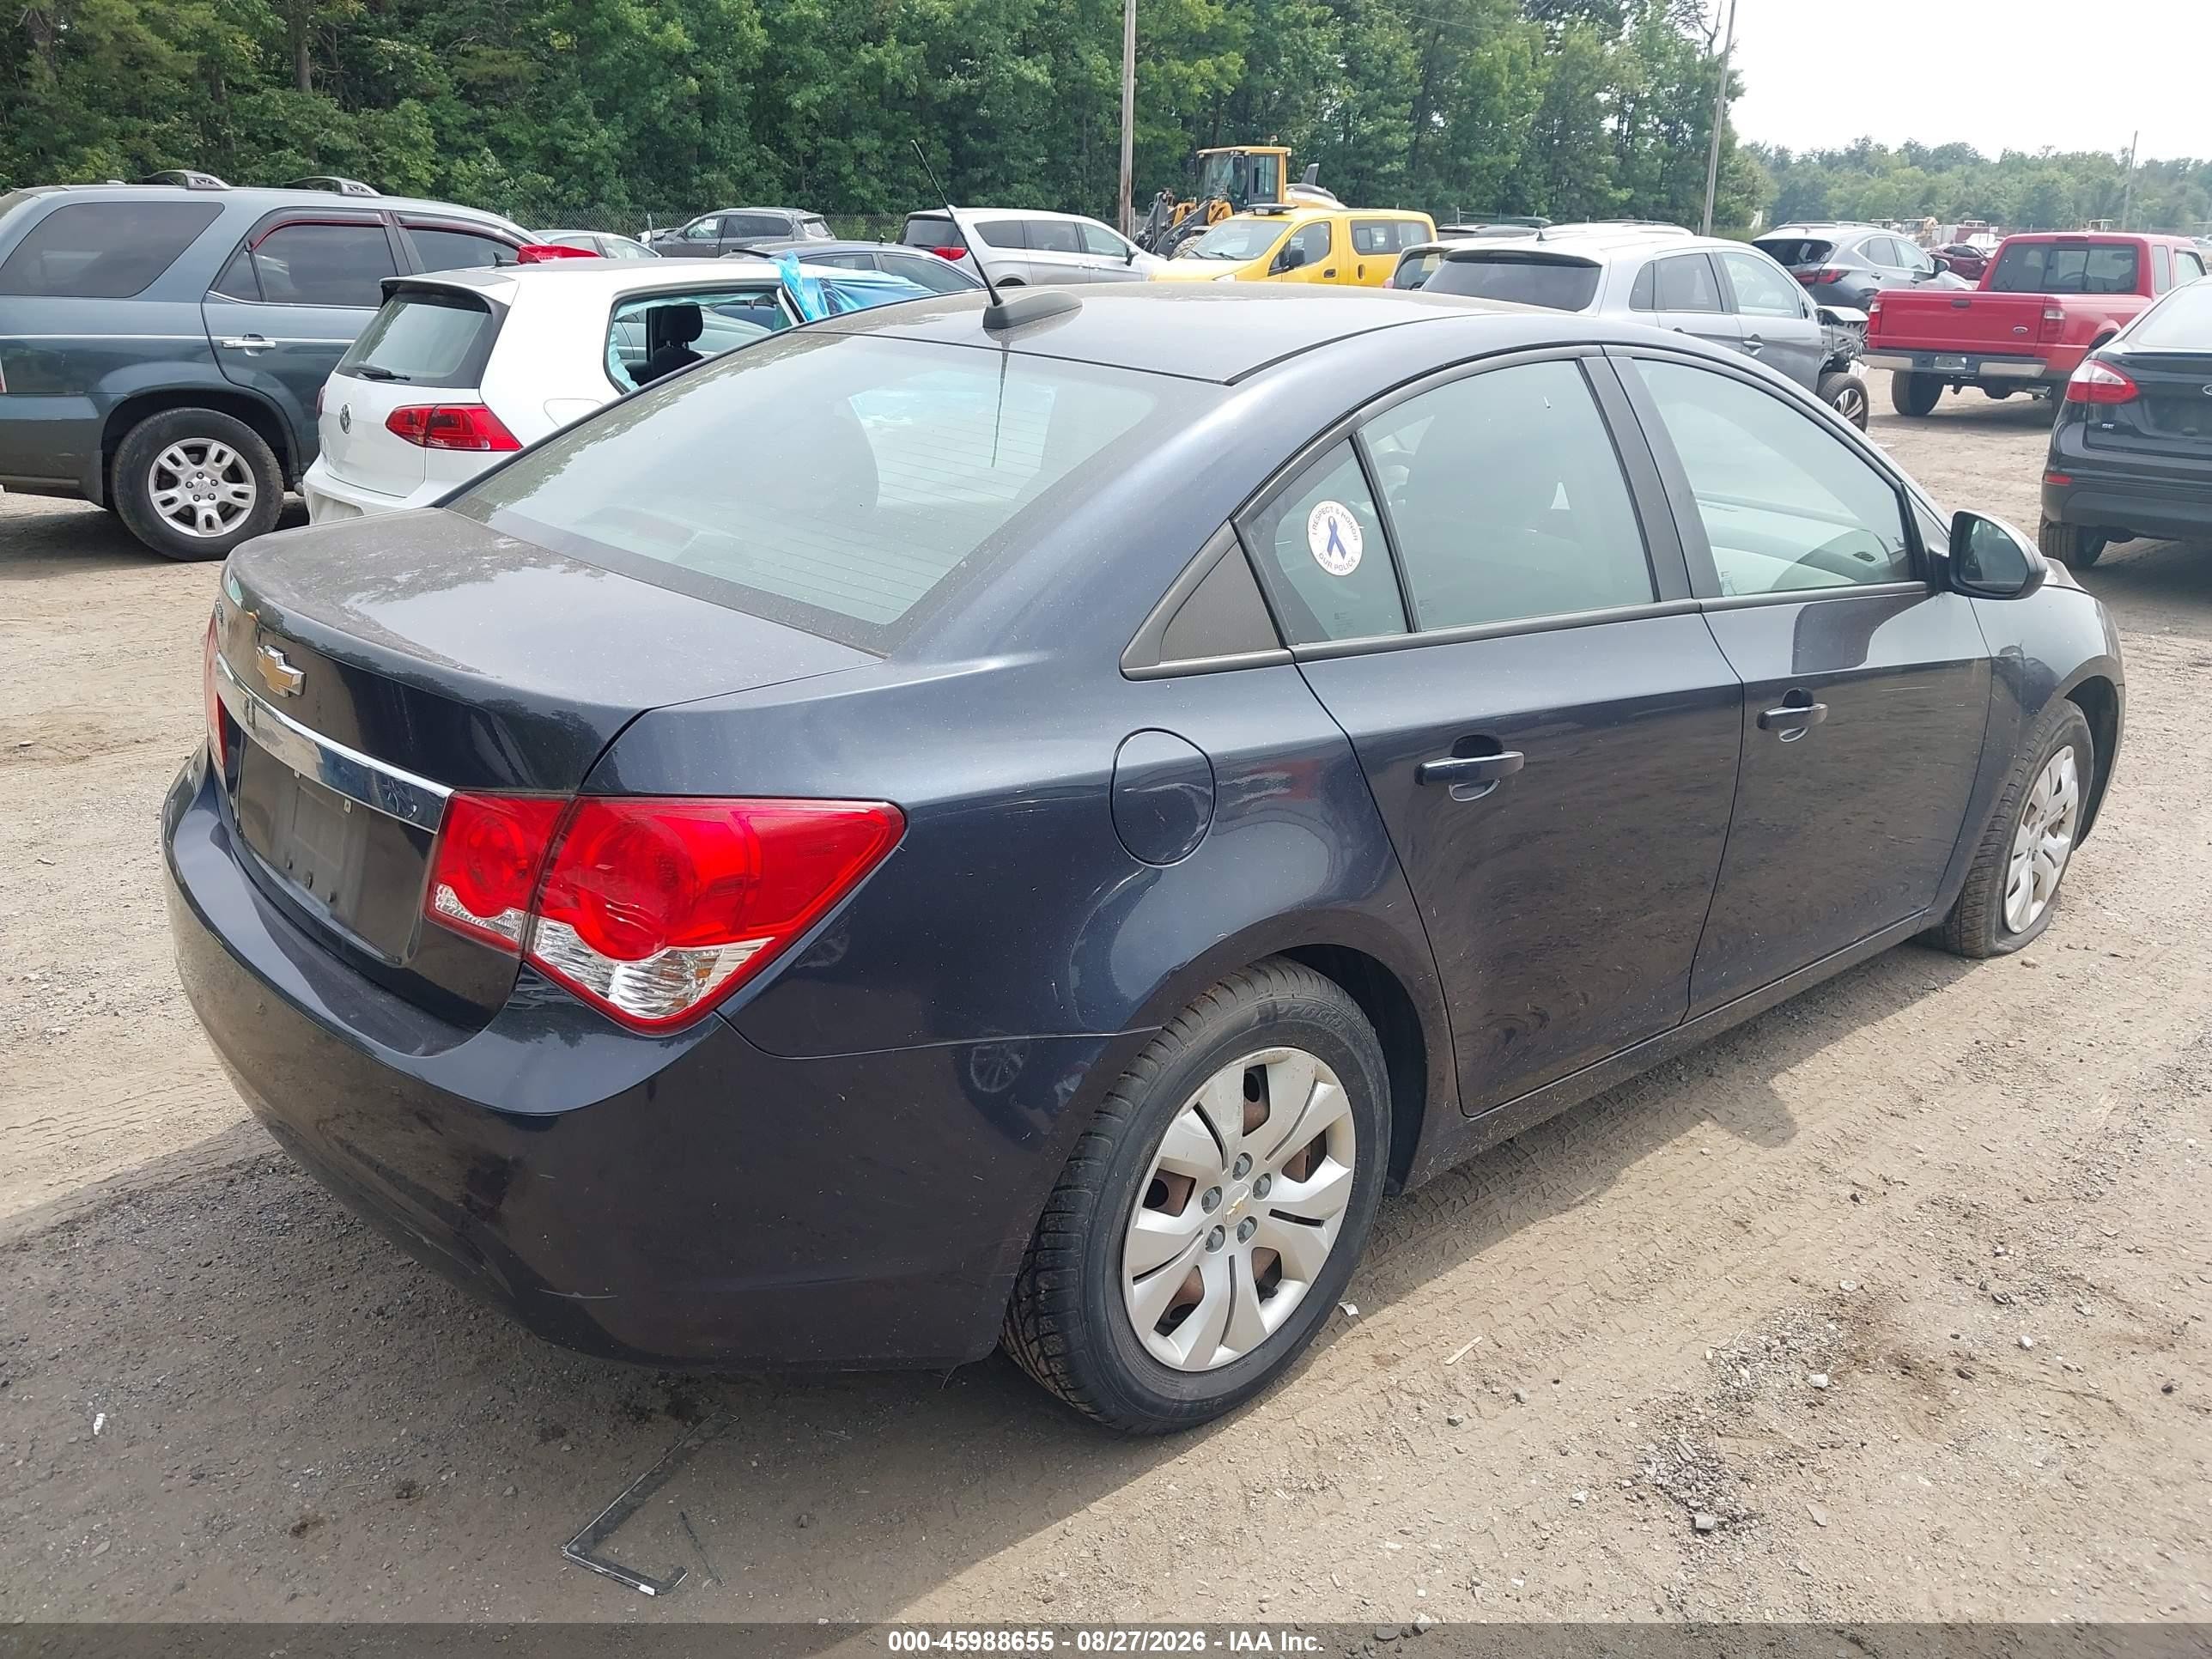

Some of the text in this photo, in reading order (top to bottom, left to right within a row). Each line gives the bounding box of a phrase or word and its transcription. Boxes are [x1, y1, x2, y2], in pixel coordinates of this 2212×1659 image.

[1312, 506, 1334, 531] RESPECT
[1340, 512, 1358, 541] HONOR
[1318, 552, 1356, 571] OUR POLICE
